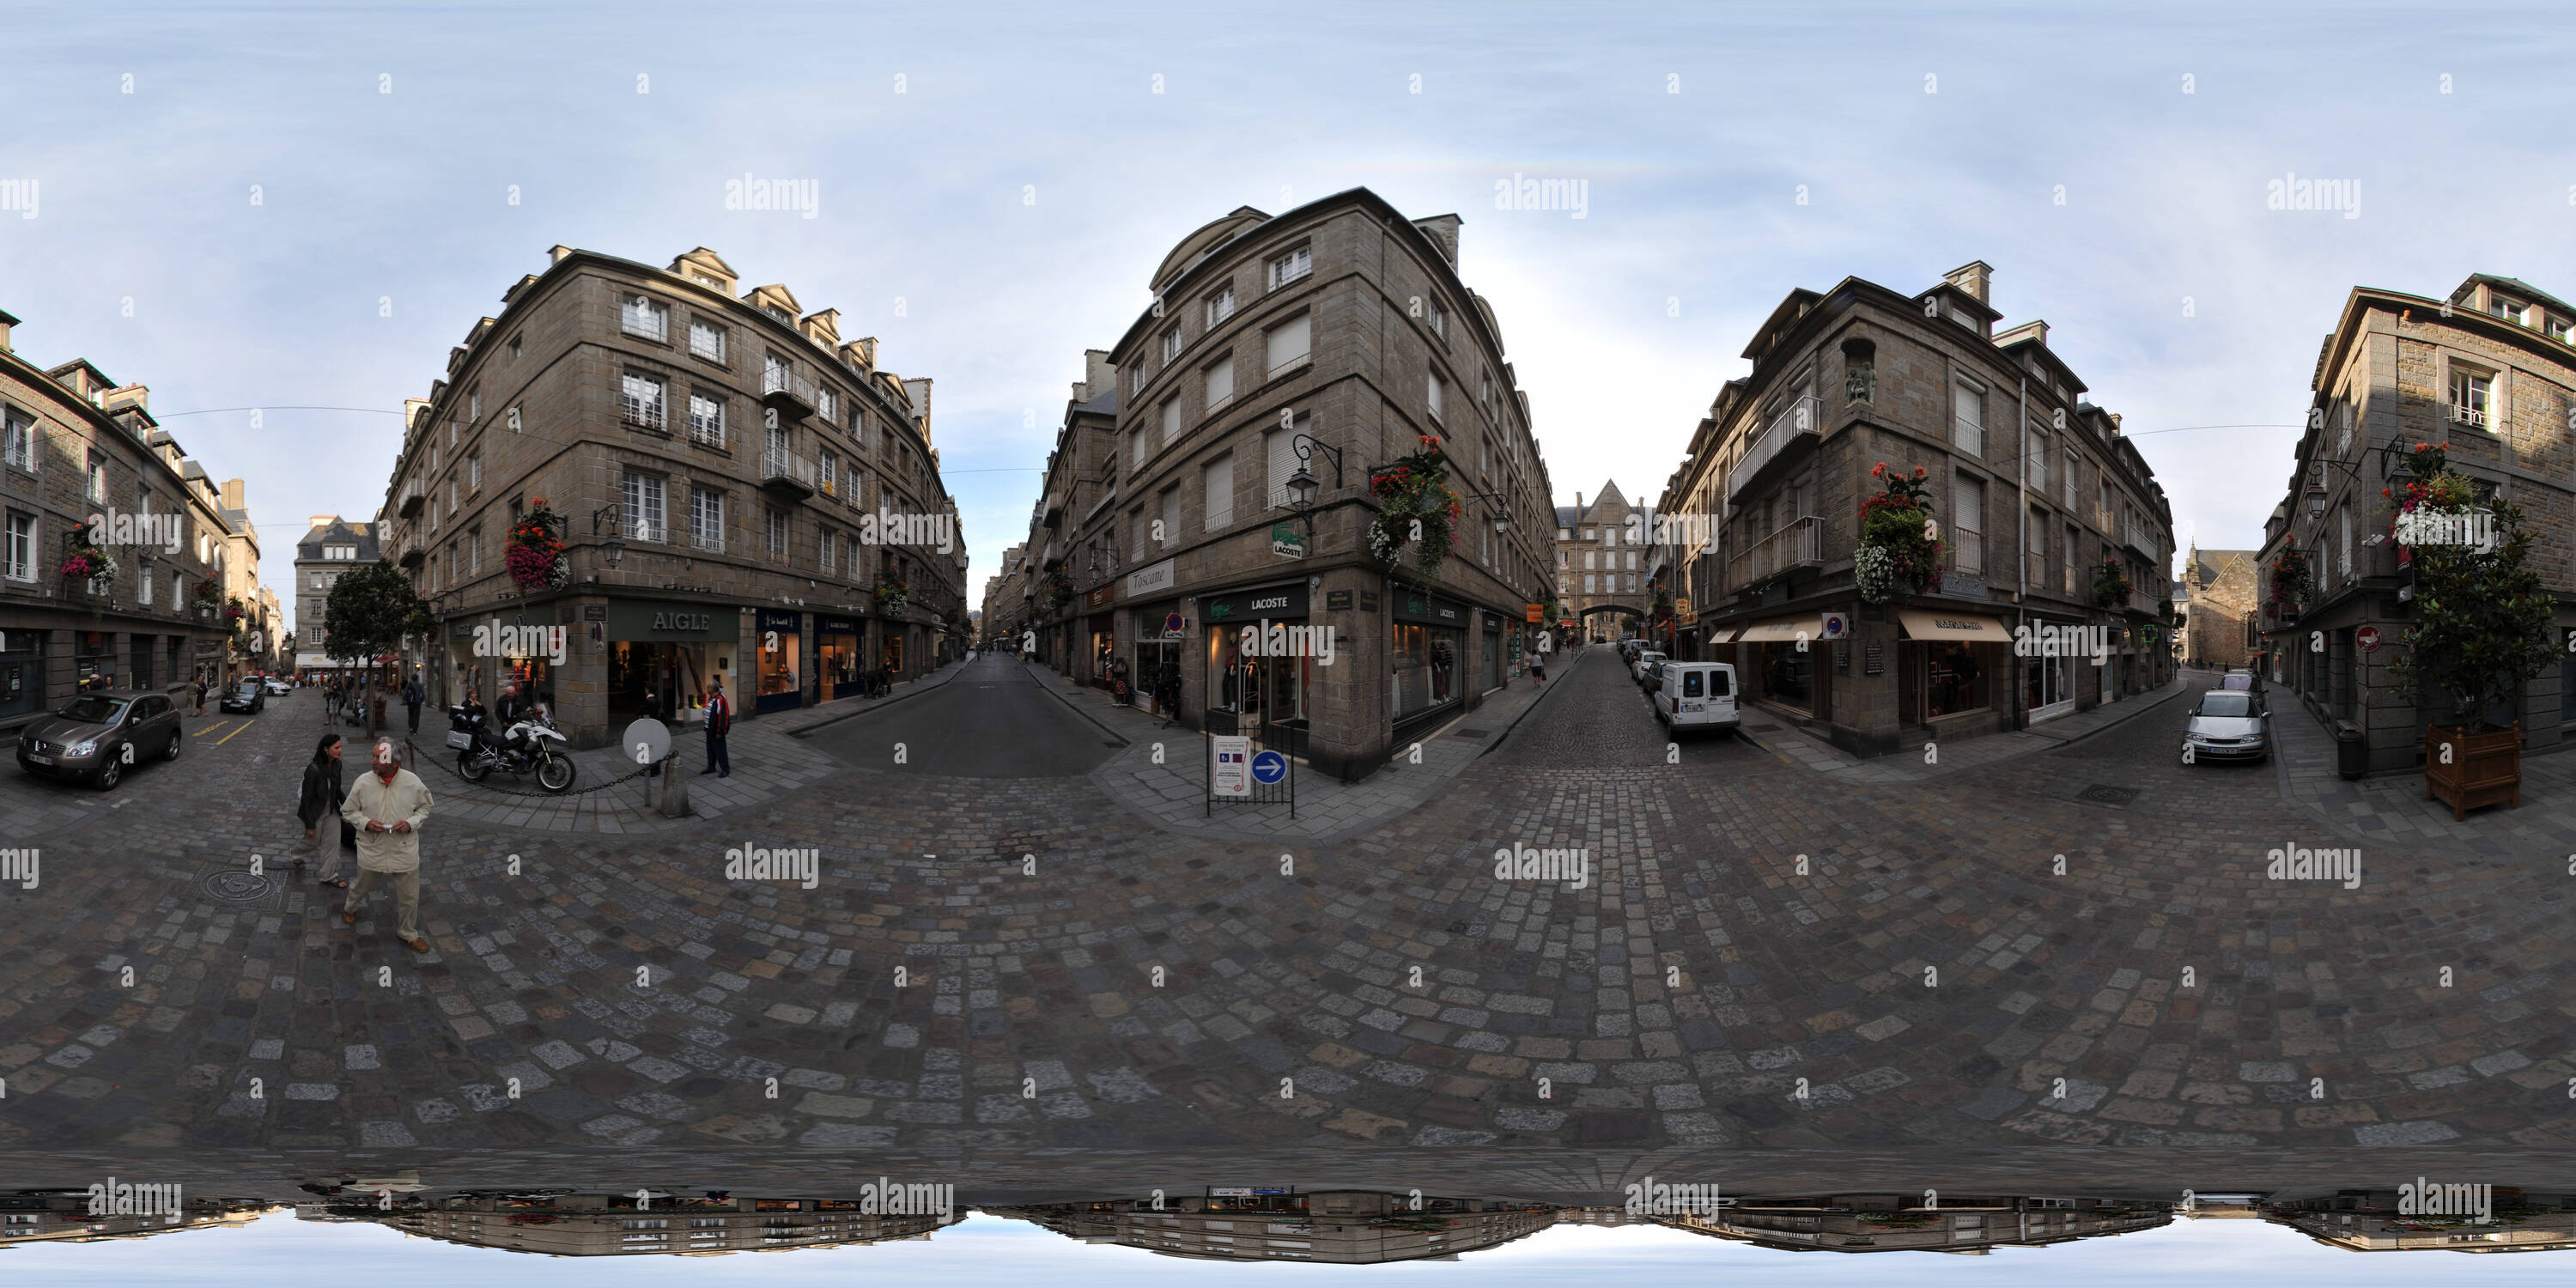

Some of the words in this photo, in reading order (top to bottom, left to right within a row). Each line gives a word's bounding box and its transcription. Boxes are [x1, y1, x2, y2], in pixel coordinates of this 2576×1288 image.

[1274, 545, 1301, 557] LACOSTE
[1133, 568, 1165, 589] Toscane
[1251, 597, 1288, 610] LACOSTE
[652, 611, 709, 631] AIGLE
